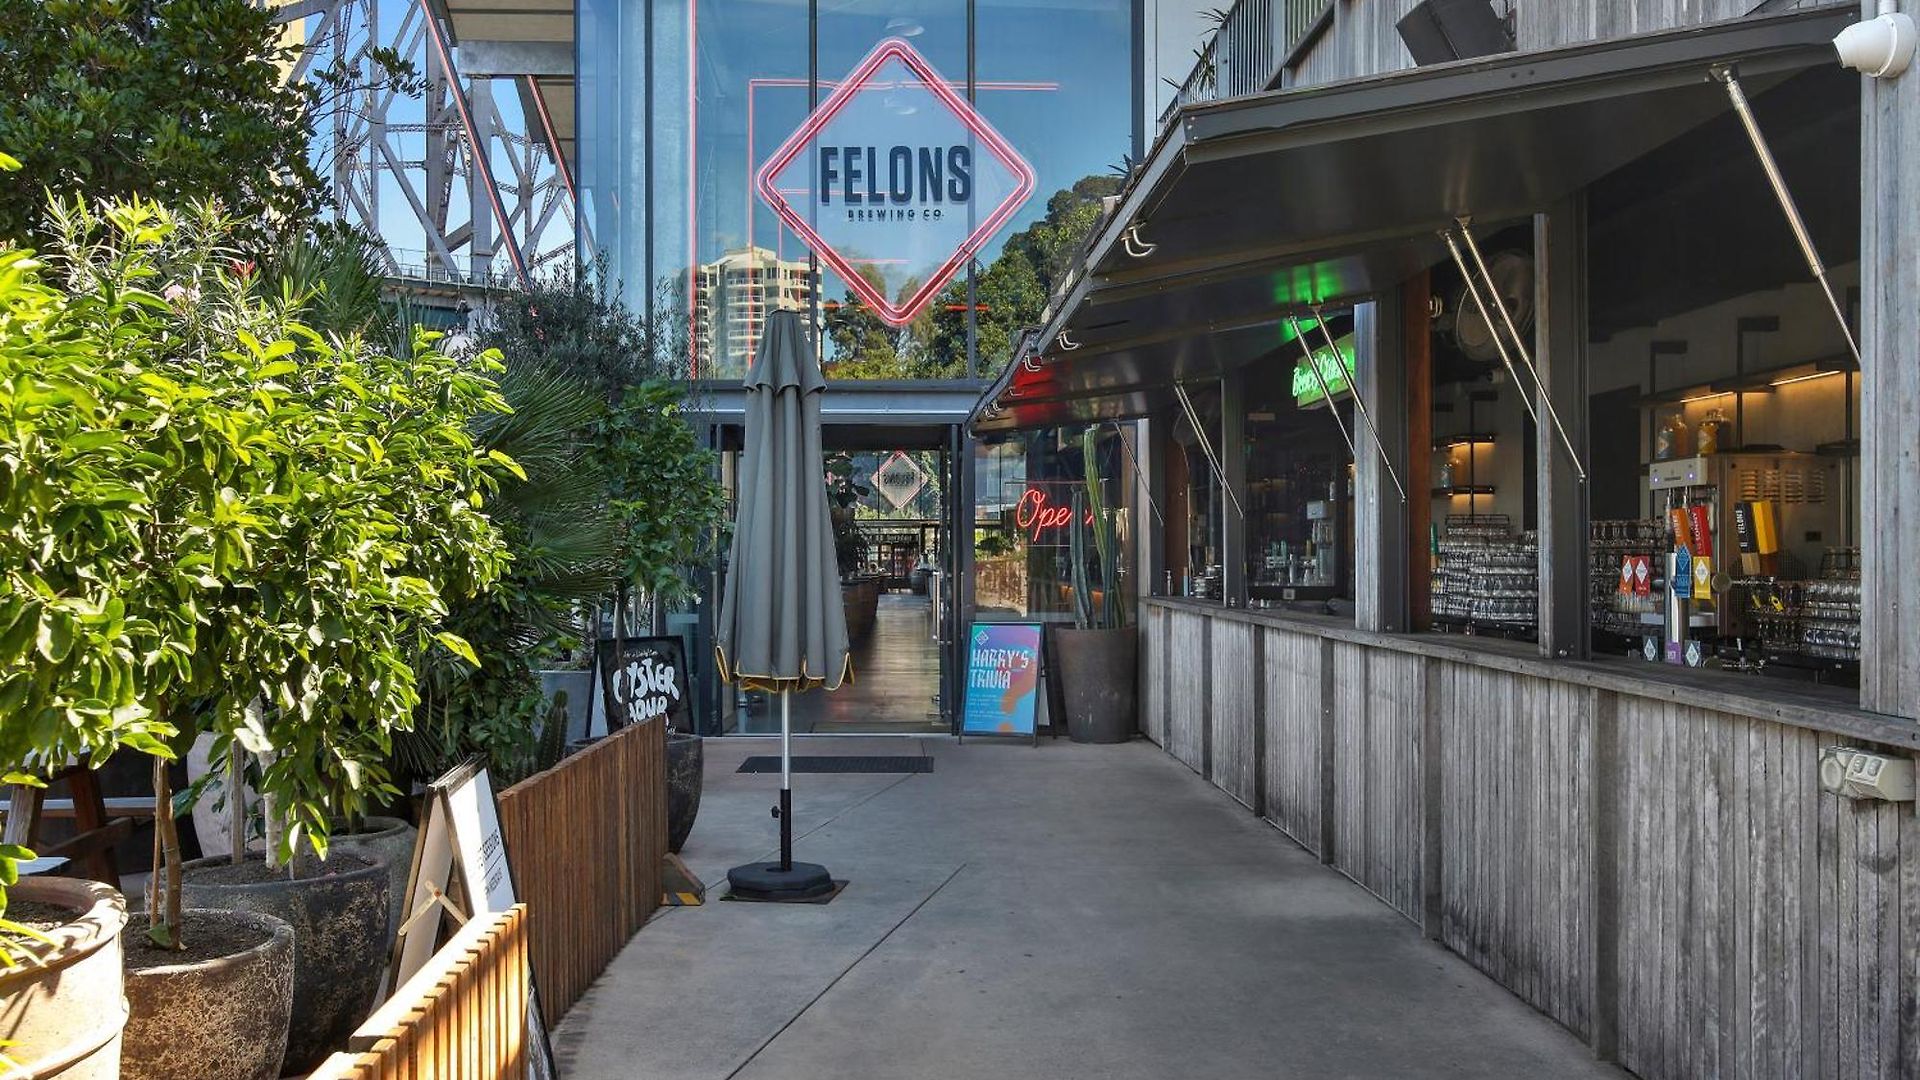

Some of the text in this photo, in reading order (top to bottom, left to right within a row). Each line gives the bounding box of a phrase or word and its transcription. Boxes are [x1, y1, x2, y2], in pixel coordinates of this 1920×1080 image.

[820, 146, 971, 204] FELONS
[848, 209, 944, 220] BREWING CO.
[971, 648, 1030, 669] HARRY'S
[969, 669, 1012, 689] TRIVIA
